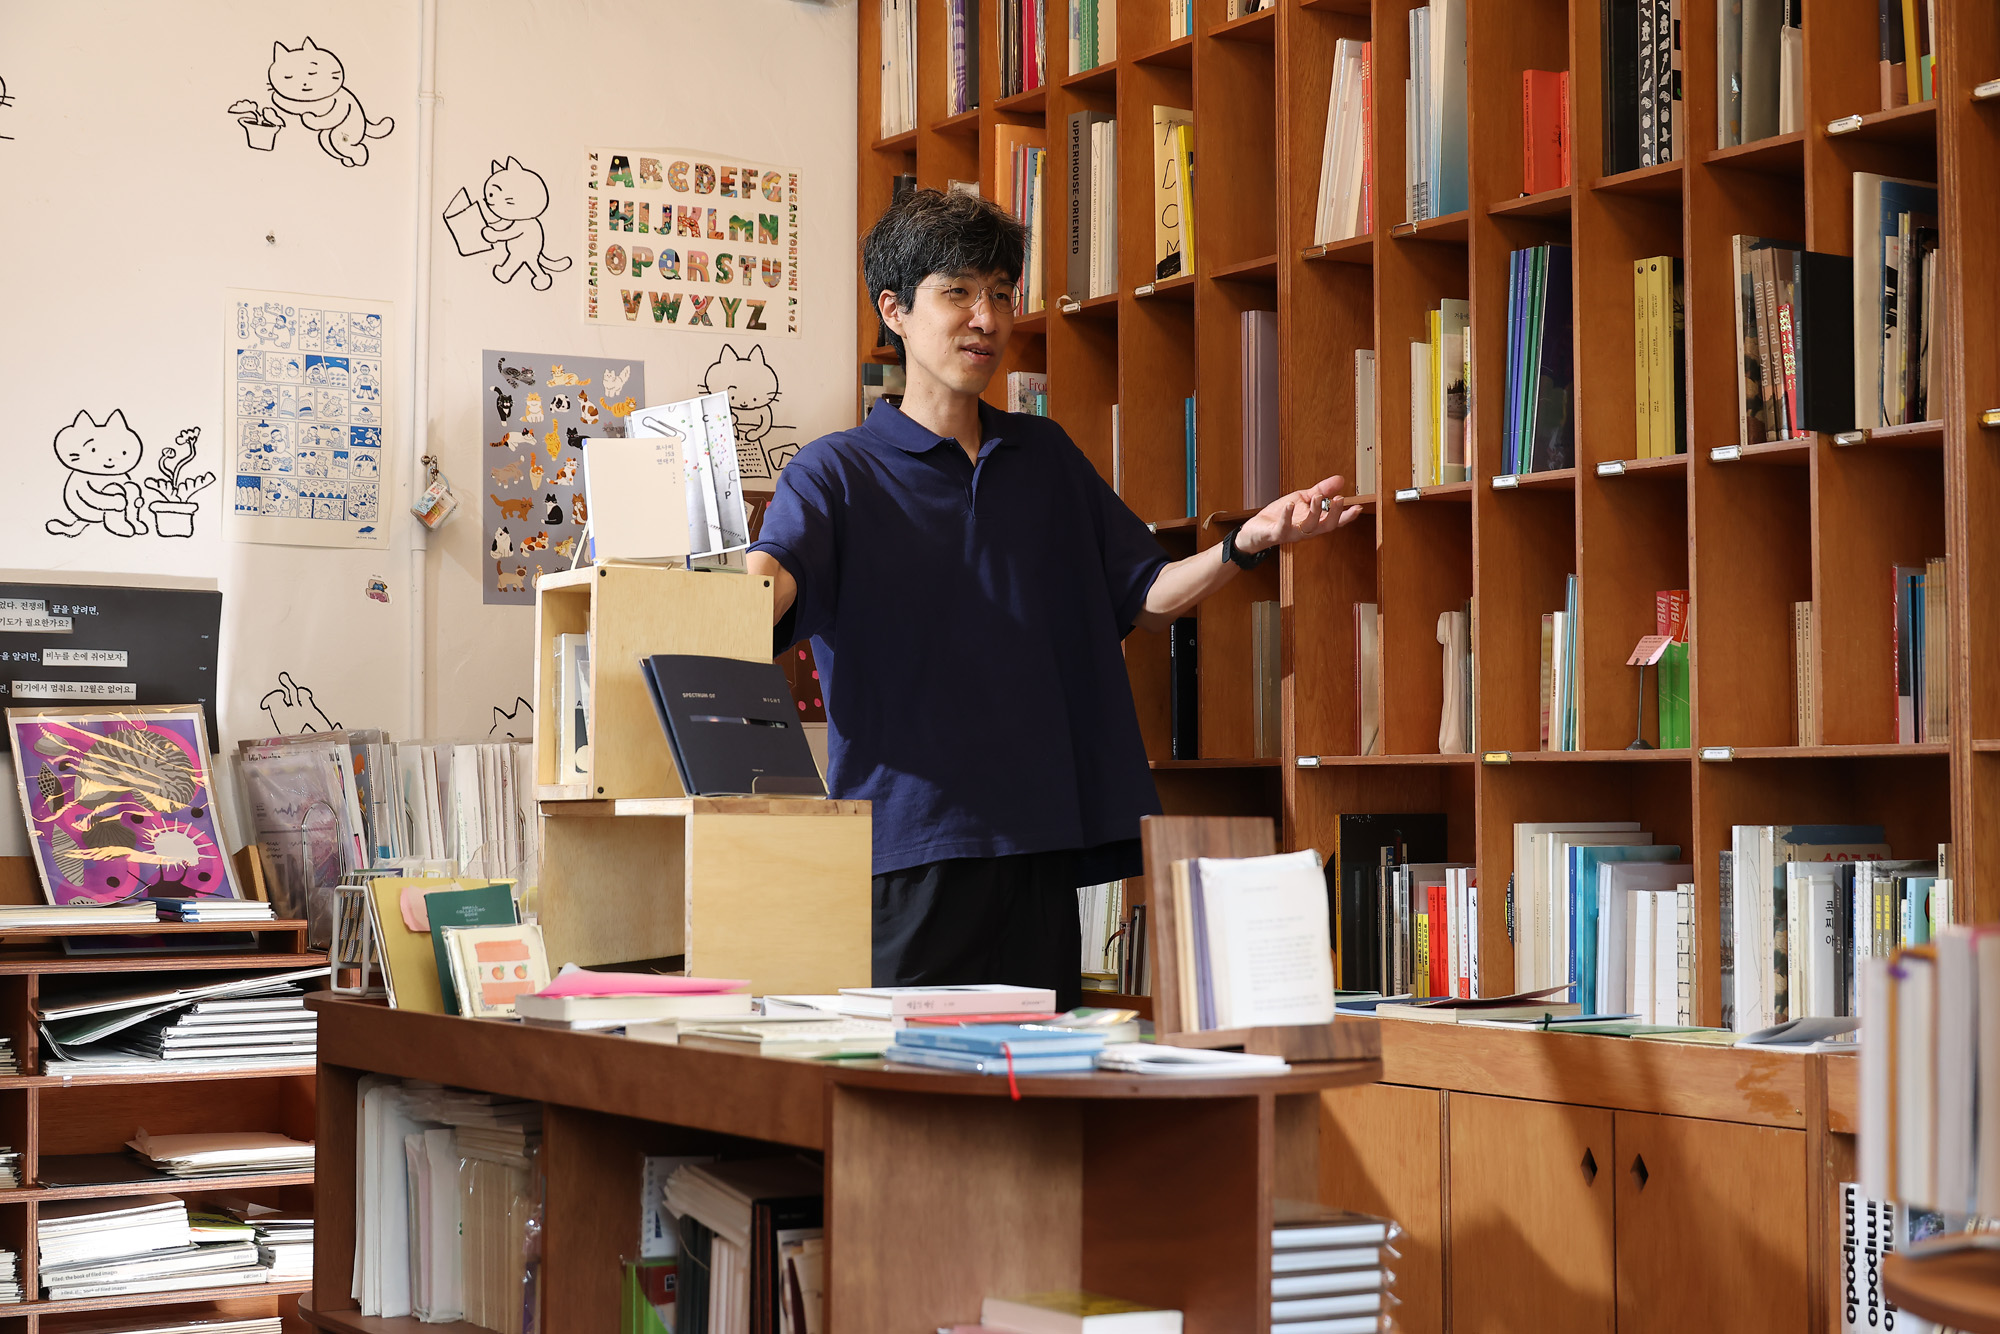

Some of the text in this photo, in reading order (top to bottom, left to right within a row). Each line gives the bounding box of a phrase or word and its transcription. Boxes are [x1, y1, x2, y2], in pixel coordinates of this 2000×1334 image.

[789, 172, 798, 228] IKEGAMI
[1072, 120, 1080, 255] UPPERHOUSE-ORIENTED
[588, 261, 599, 319] IKEGAMI
[1754, 281, 1769, 387] Killing and Dying
[1765, 280, 1781, 385] Killing and Dying
[20, 602, 44, 611] 전쟁의
[52, 604, 70, 614] 끝을
[72, 605, 100, 616] 알려면,
[26, 618, 70, 628] 필요한가요?
[12, 652, 41, 663] 알려면,
[46, 651, 70, 661] 비누를
[73, 652, 88, 661] 손에
[91, 652, 126, 662] 쥐어보자.
[50, 684, 76, 693] 멈춰요.
[80, 684, 104, 694] 12월은
[108, 685, 134, 694] 없어요.
[101, 1270, 118, 1278] images
[1843, 1187, 1860, 1324] umipodo
